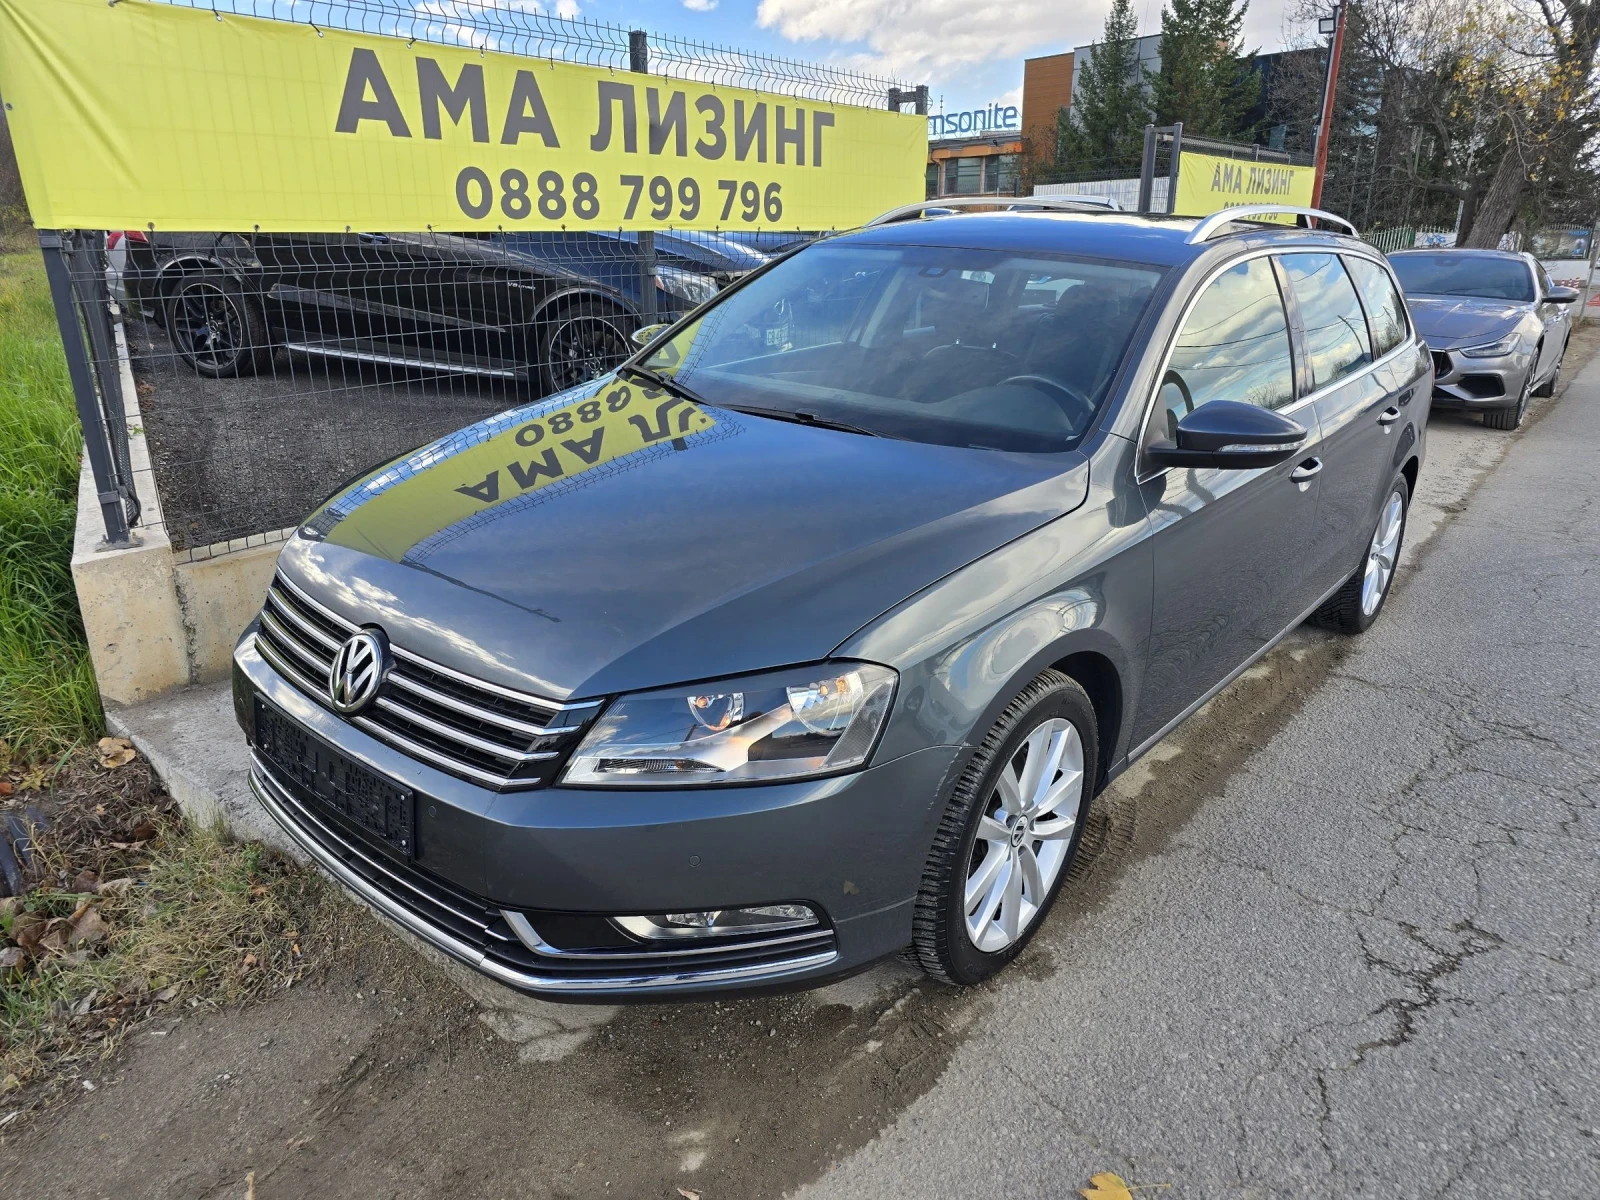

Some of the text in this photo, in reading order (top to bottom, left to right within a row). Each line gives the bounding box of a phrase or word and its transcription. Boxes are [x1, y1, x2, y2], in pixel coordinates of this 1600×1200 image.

[335, 48, 835, 167] АМА ЛИЗИНГ
[456, 167, 783, 222] 0888 799 796
[1210, 162, 1295, 195] АМА ЛИЗИНГ
